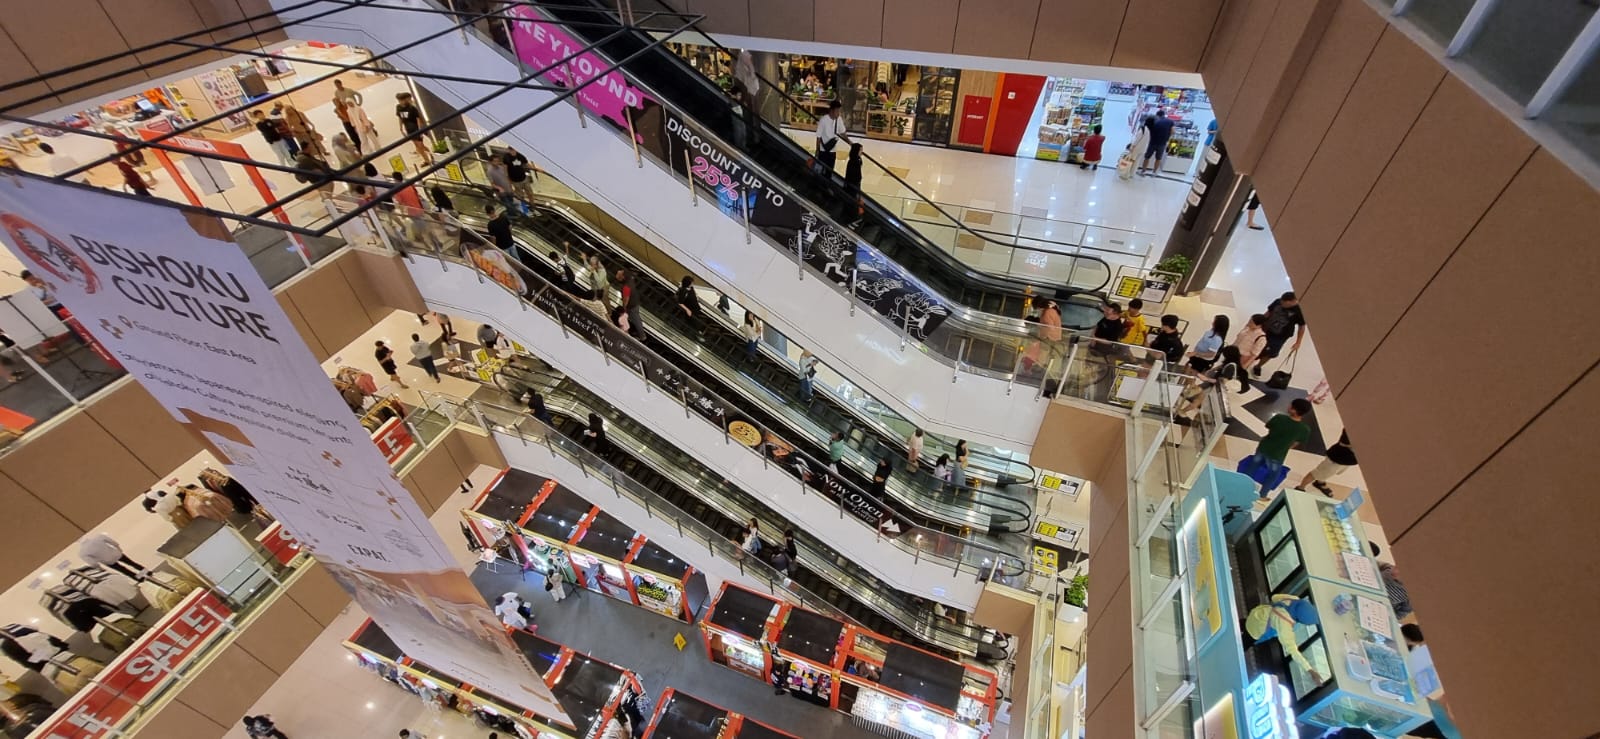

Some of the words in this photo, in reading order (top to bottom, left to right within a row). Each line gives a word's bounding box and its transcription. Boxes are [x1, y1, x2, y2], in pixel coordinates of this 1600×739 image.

[667, 118, 740, 174] DISCOUNT
[742, 171, 763, 189] UP
[765, 187, 784, 206] TO
[691, 156, 740, 201] 25%
[70, 234, 250, 303] BISHOKU
[112, 275, 280, 345] CULTURE
[819, 474, 850, 494] Now
[849, 493, 884, 518] Open
